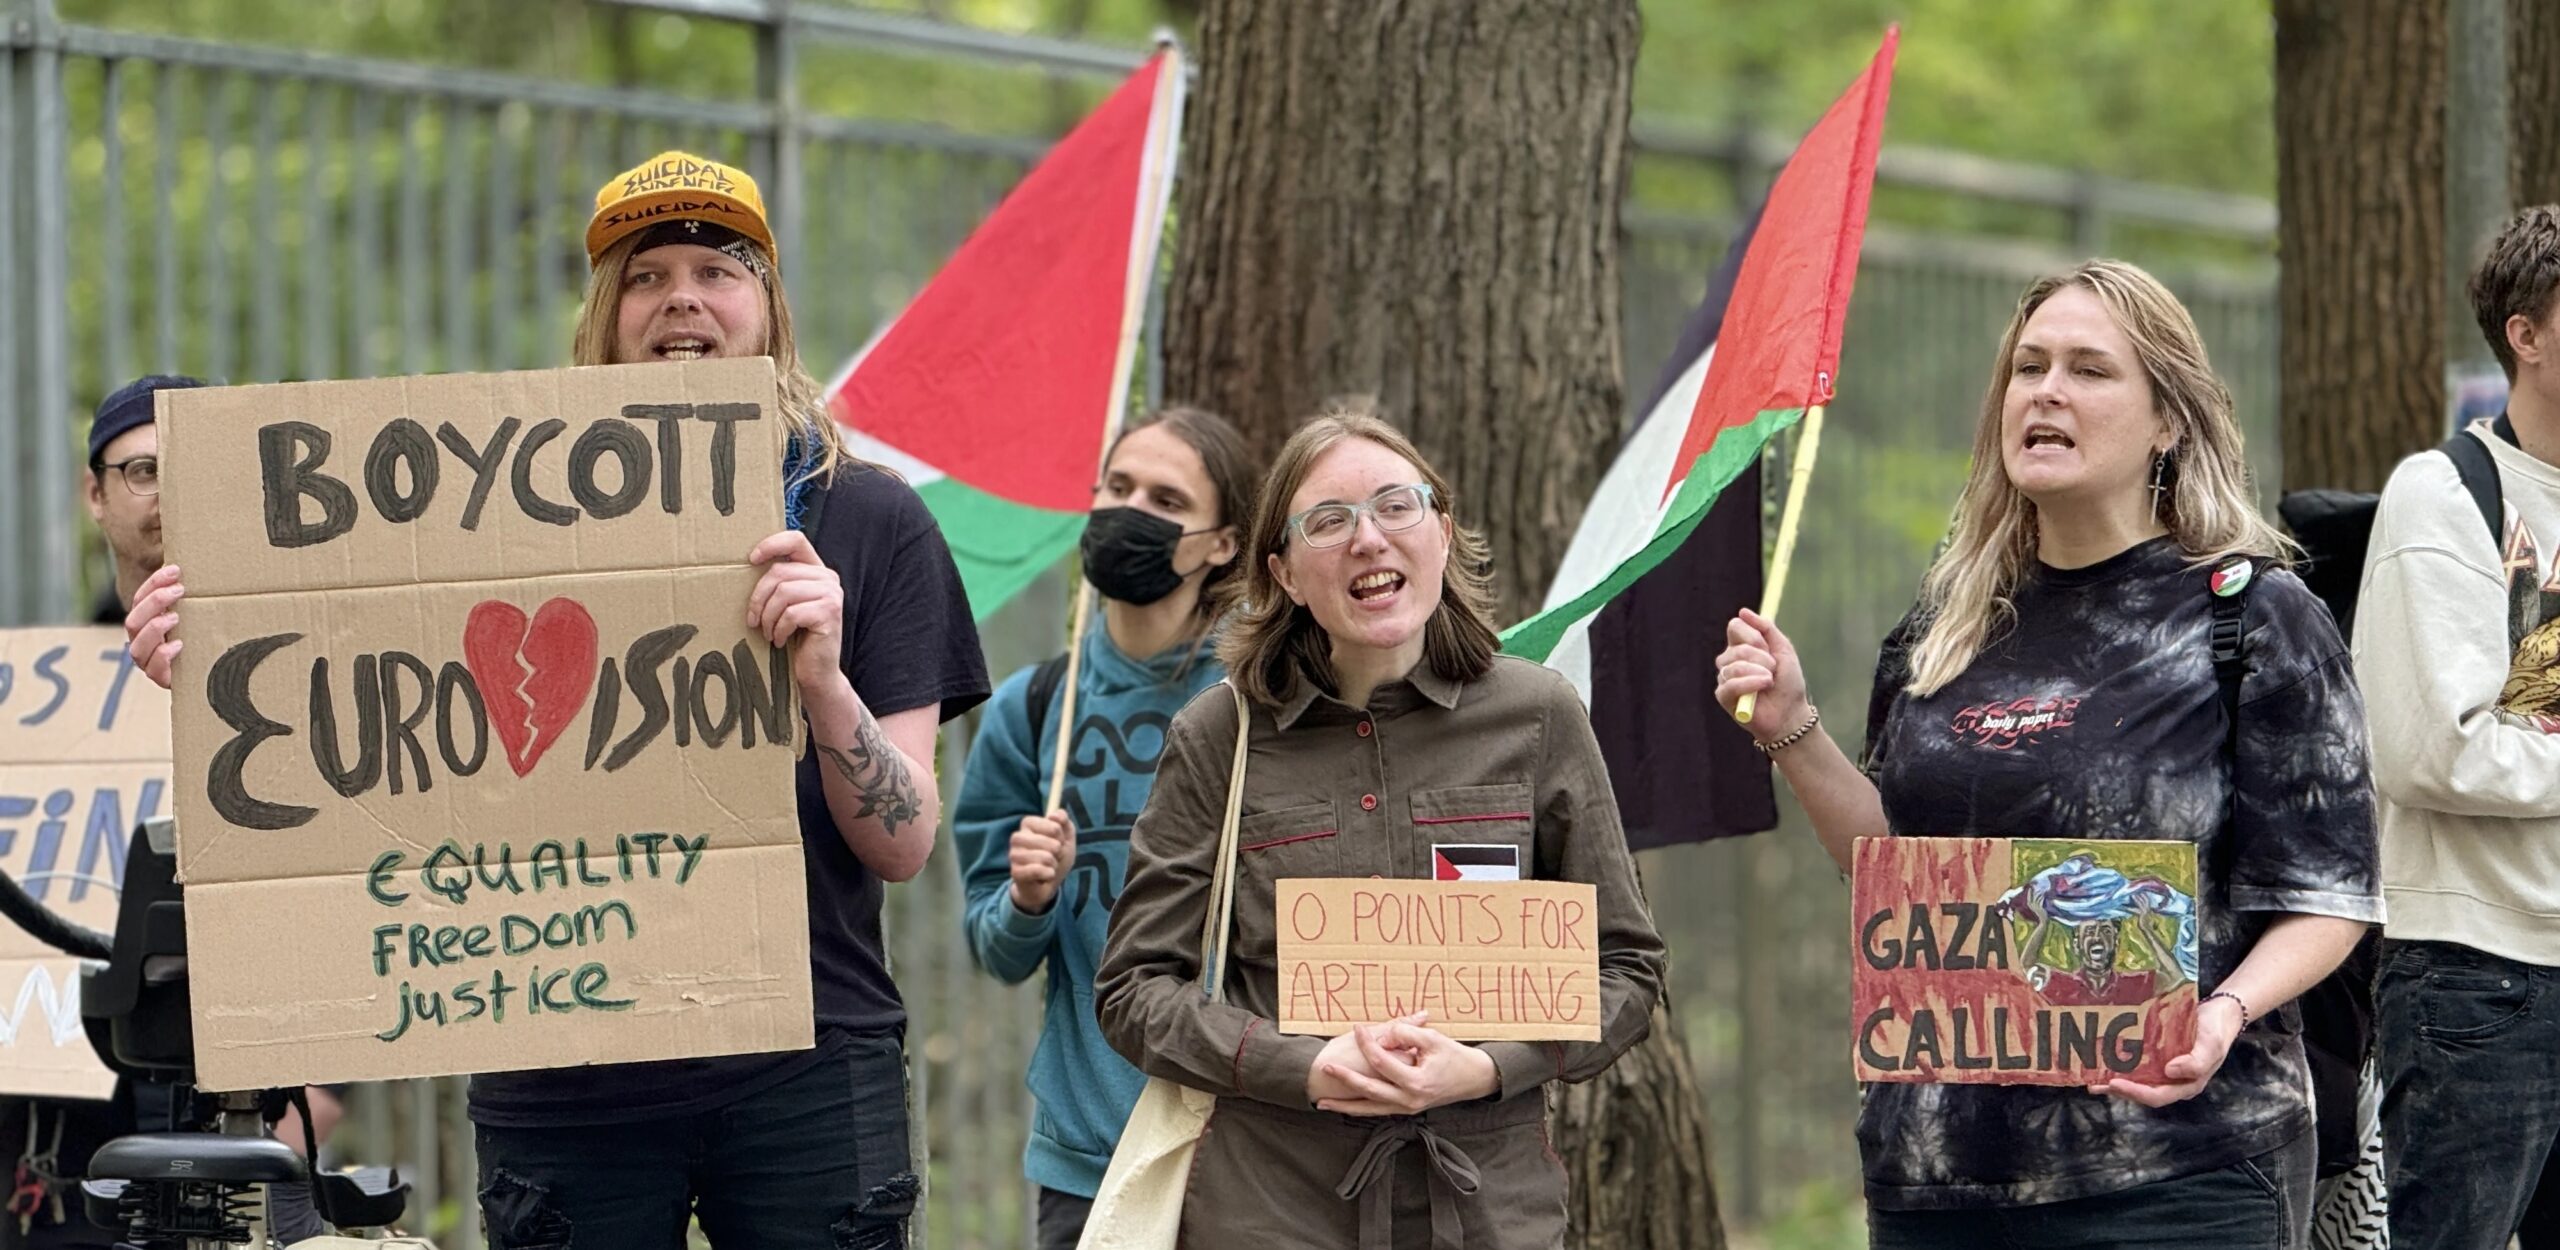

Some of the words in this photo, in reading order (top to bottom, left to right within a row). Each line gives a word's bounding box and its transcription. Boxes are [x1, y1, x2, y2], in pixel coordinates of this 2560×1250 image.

[622, 159, 735, 196] SUICIDAL
[605, 201, 746, 229] SUICIDAL
[258, 402, 762, 548] BOYCOTT
[367, 832, 709, 906] EQUALITY
[1354, 892, 1502, 945] POINTS
[1519, 898, 1585, 951] FOR
[1862, 902, 2008, 970] GAZA
[1289, 962, 1582, 1022] ARTWASHING
[1859, 1007, 2144, 1073] CALLING
